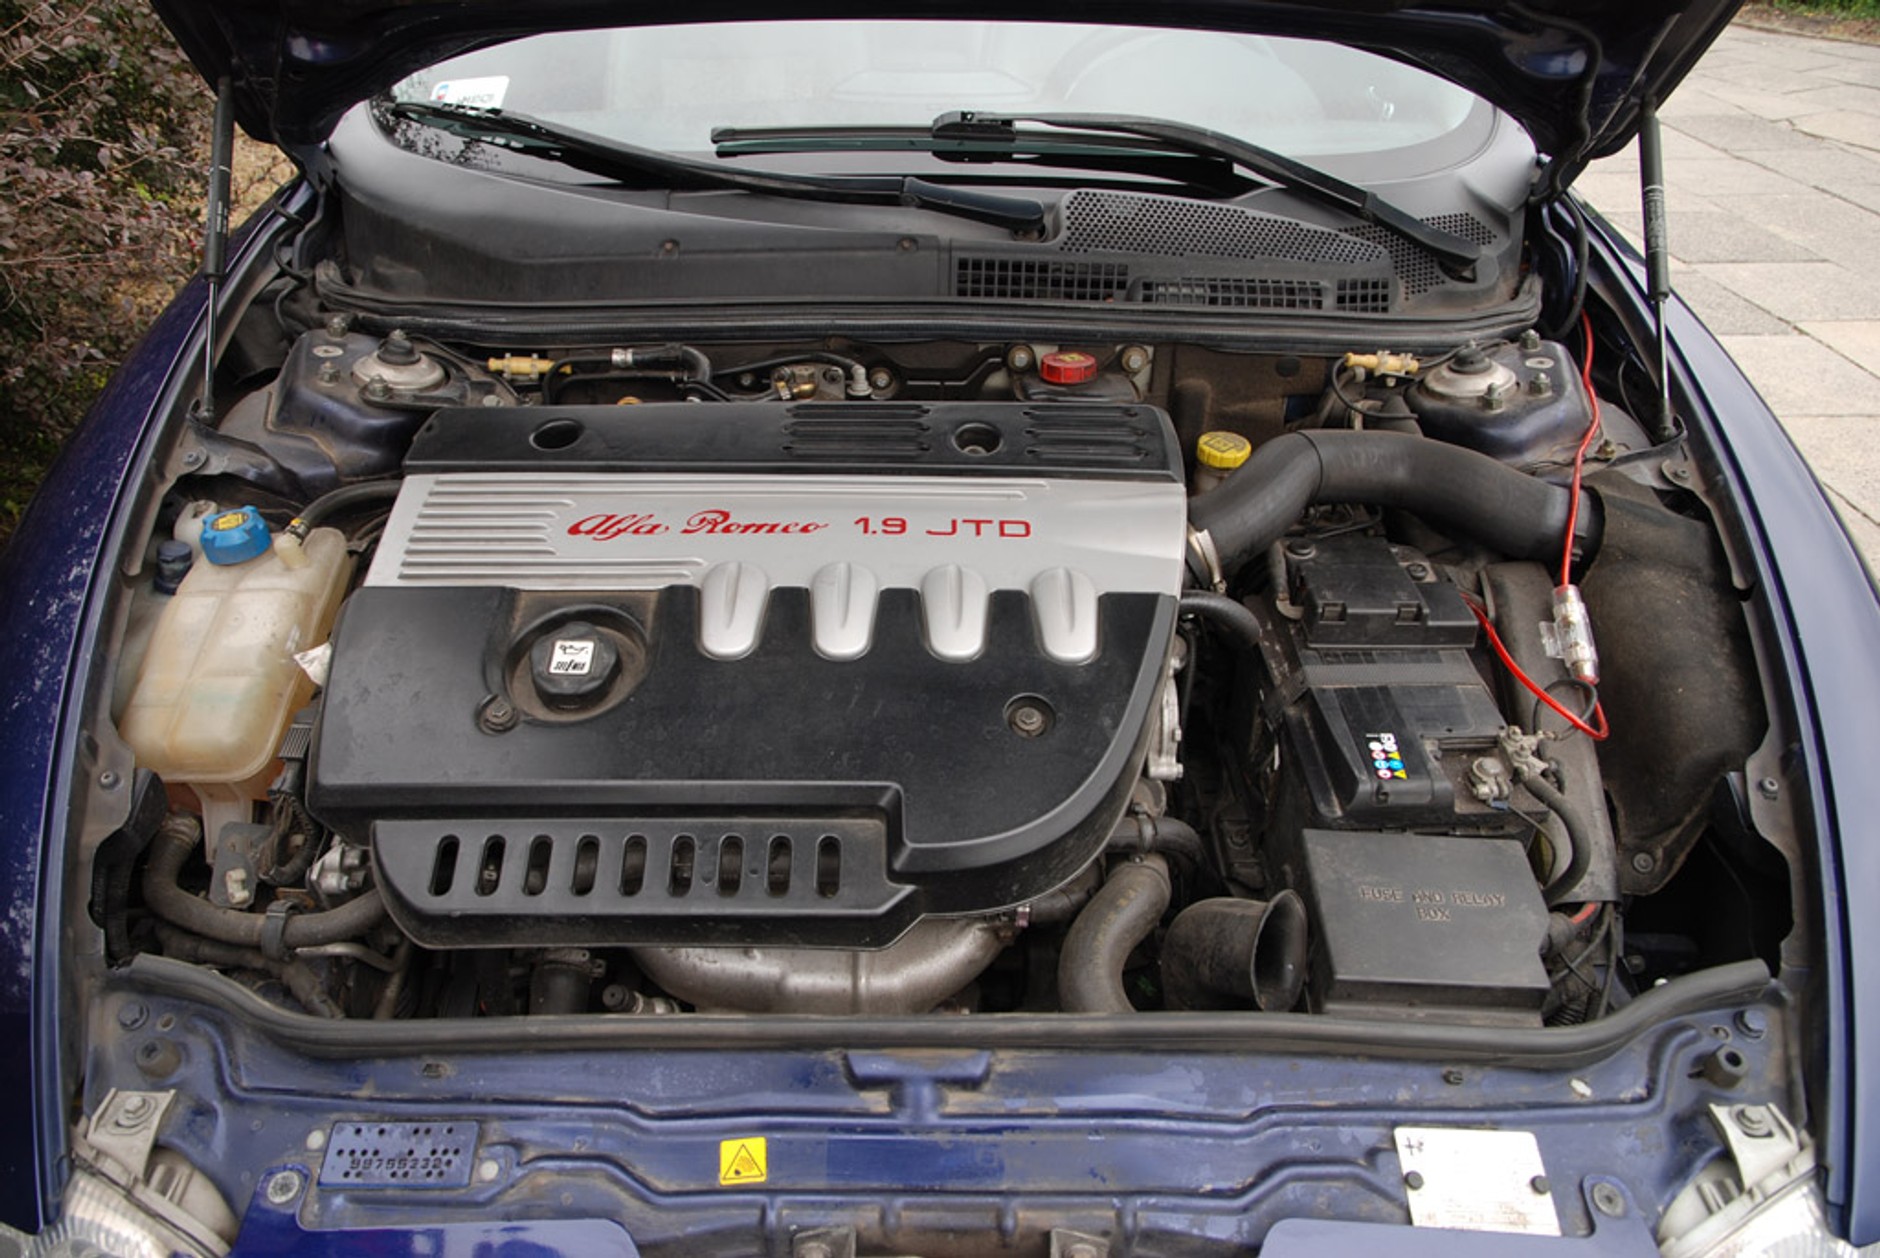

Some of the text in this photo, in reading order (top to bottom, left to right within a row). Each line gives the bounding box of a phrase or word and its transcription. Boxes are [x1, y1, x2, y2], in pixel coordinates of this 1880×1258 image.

[566, 508, 1033, 542] Alfa Romeo 1.9 JTD
[1360, 886, 1505, 907] FUSE AND RELAY
[1416, 906, 1451, 921] BOX
